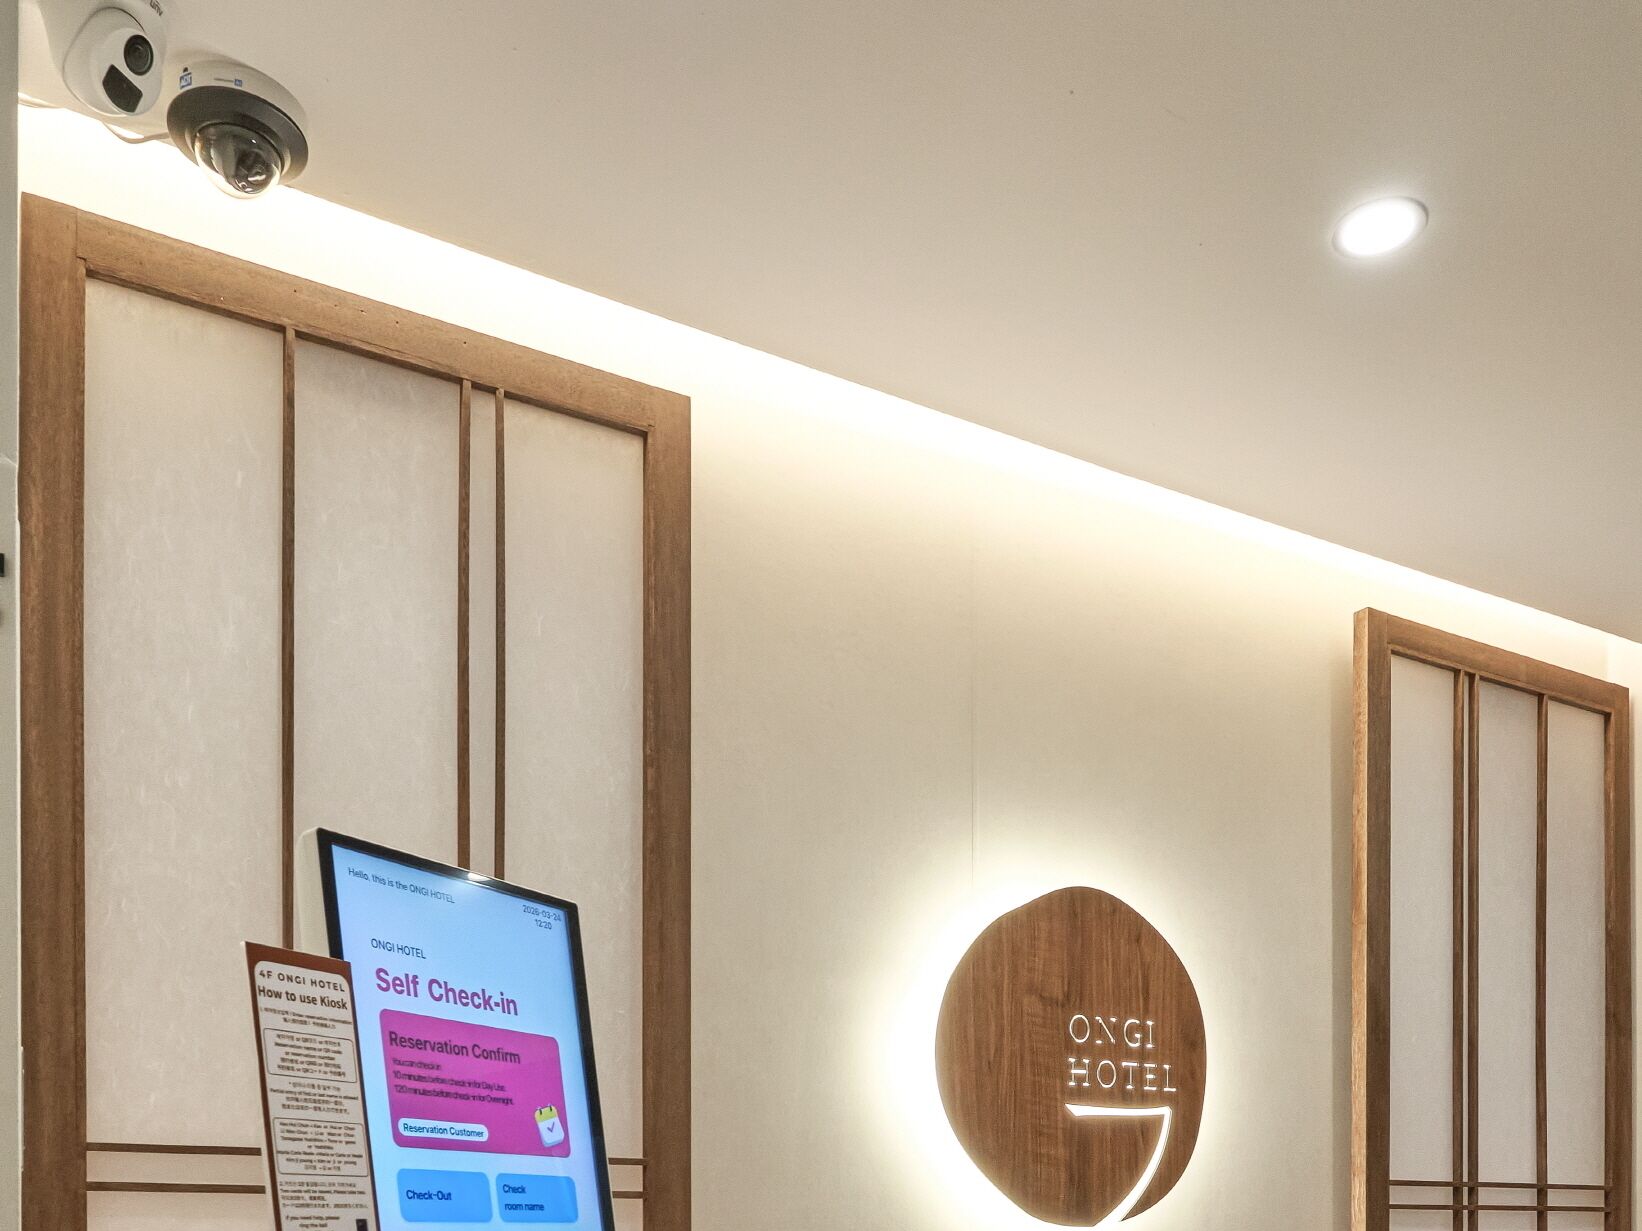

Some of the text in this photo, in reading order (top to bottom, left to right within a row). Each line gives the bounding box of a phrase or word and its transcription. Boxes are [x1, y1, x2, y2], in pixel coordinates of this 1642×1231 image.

[348, 867, 455, 904] Hello, this is the ONGI HOTEL
[371, 938, 426, 959] ONGI HOTEL
[259, 970, 345, 992] 4F ONGI HOTEL
[375, 967, 518, 1016] Self Check-in
[257, 985, 348, 1011] How to use Kiosk
[1069, 1014, 1156, 1048] ONGI
[389, 1031, 521, 1065] Reservation Confirm
[1068, 1057, 1177, 1092] HOTEL
[403, 1123, 485, 1138] Reservation Customer
[406, 1189, 452, 1201] Check-Out
[503, 1184, 526, 1194] Check
[505, 1203, 523, 1211] room
